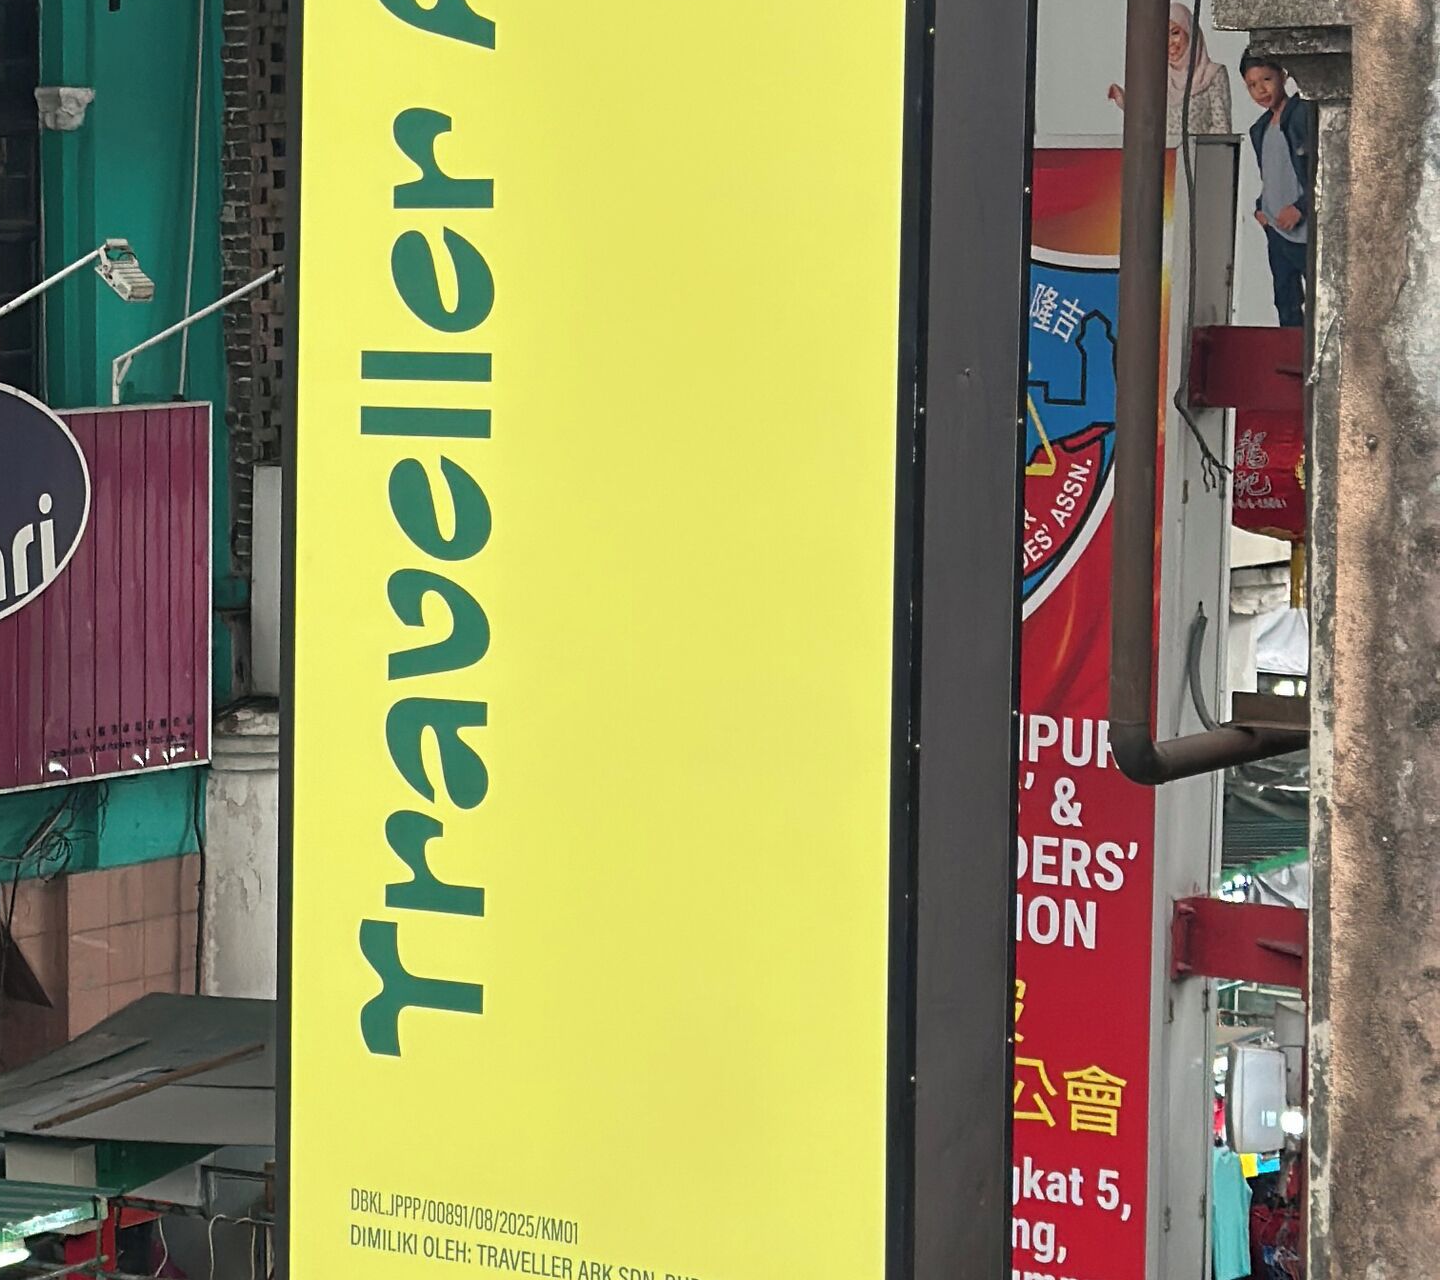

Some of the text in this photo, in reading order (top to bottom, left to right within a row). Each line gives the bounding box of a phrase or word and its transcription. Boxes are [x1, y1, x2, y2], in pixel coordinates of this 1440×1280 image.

[1049, 458, 1093, 529] ASSN.
[358, 106, 496, 1058] Traveller
[1050, 776, 1083, 828] &
[1096, 1168, 1132, 1222] 5,
[349, 1224, 418, 1256] DIMILIKI
[423, 1236, 472, 1266] OLEH:
